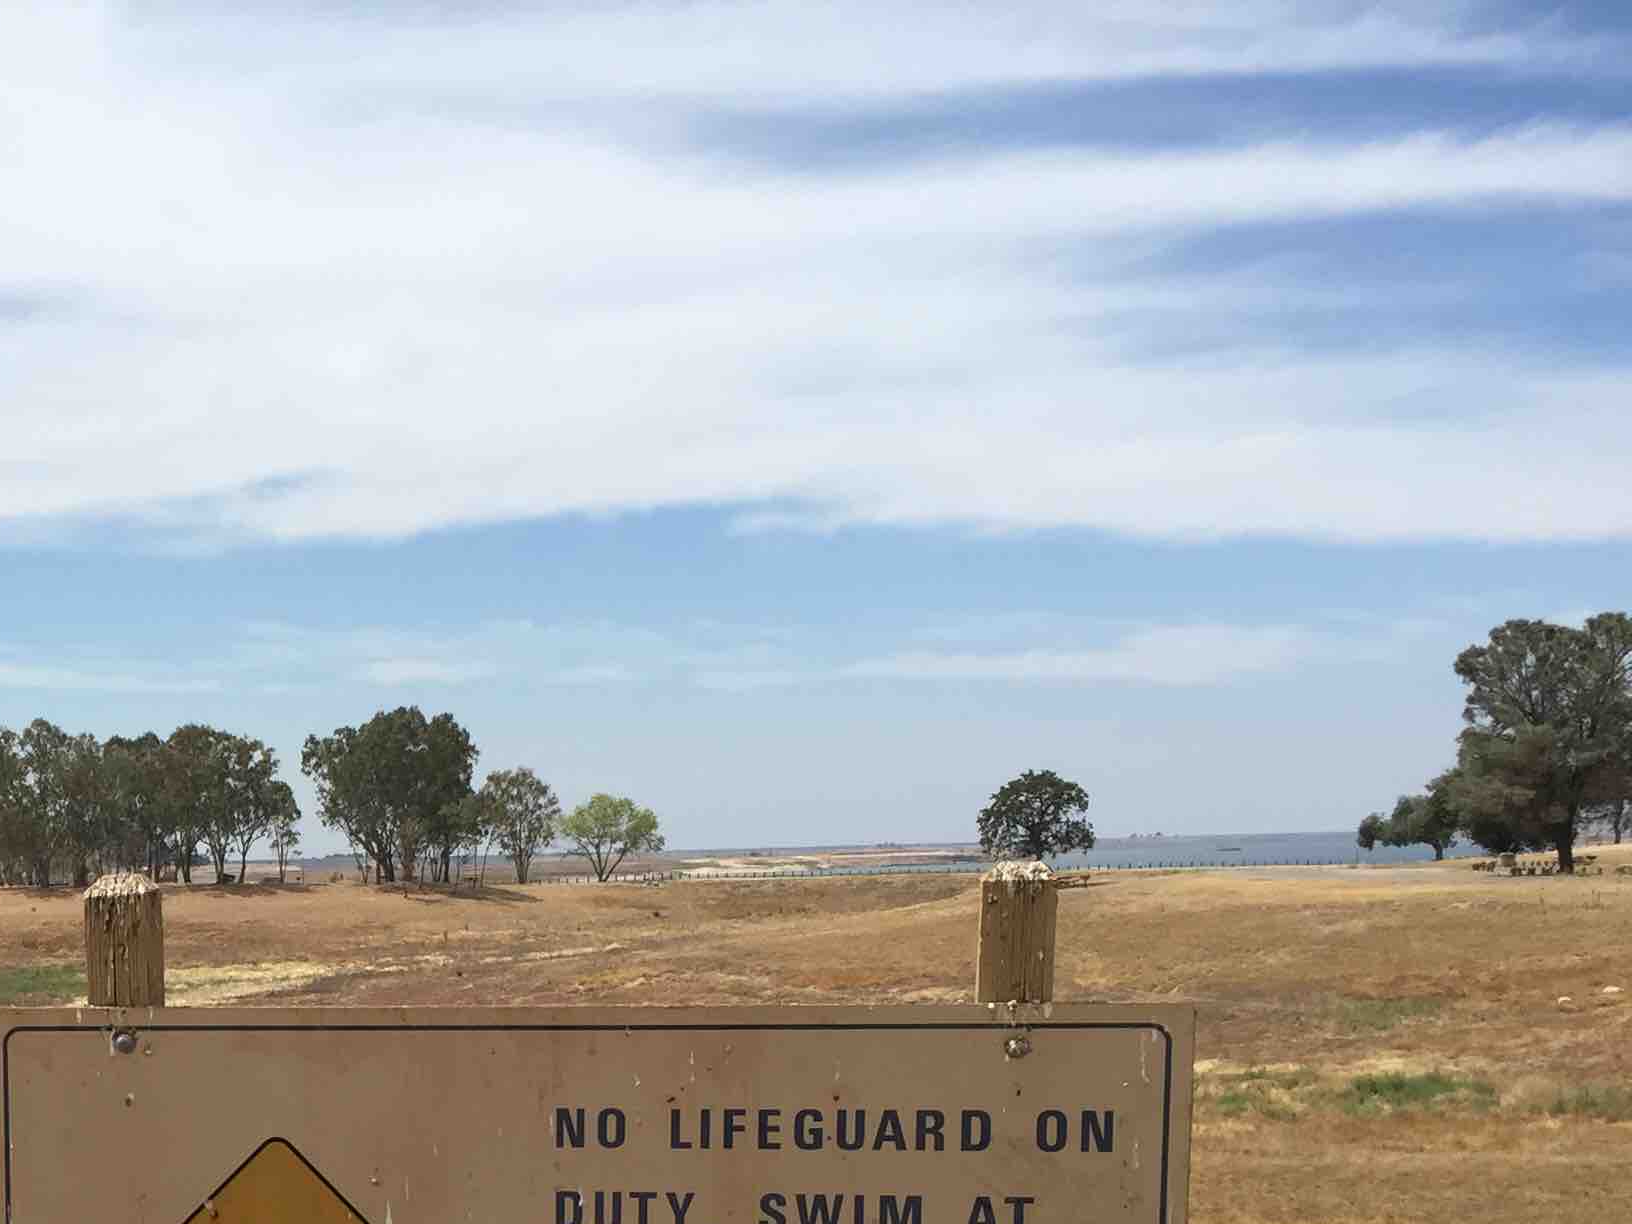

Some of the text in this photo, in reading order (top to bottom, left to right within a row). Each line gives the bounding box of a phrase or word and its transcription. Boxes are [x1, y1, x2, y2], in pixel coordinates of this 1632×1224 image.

[555, 1108, 1114, 1152] NO LIFEGUARD ON
